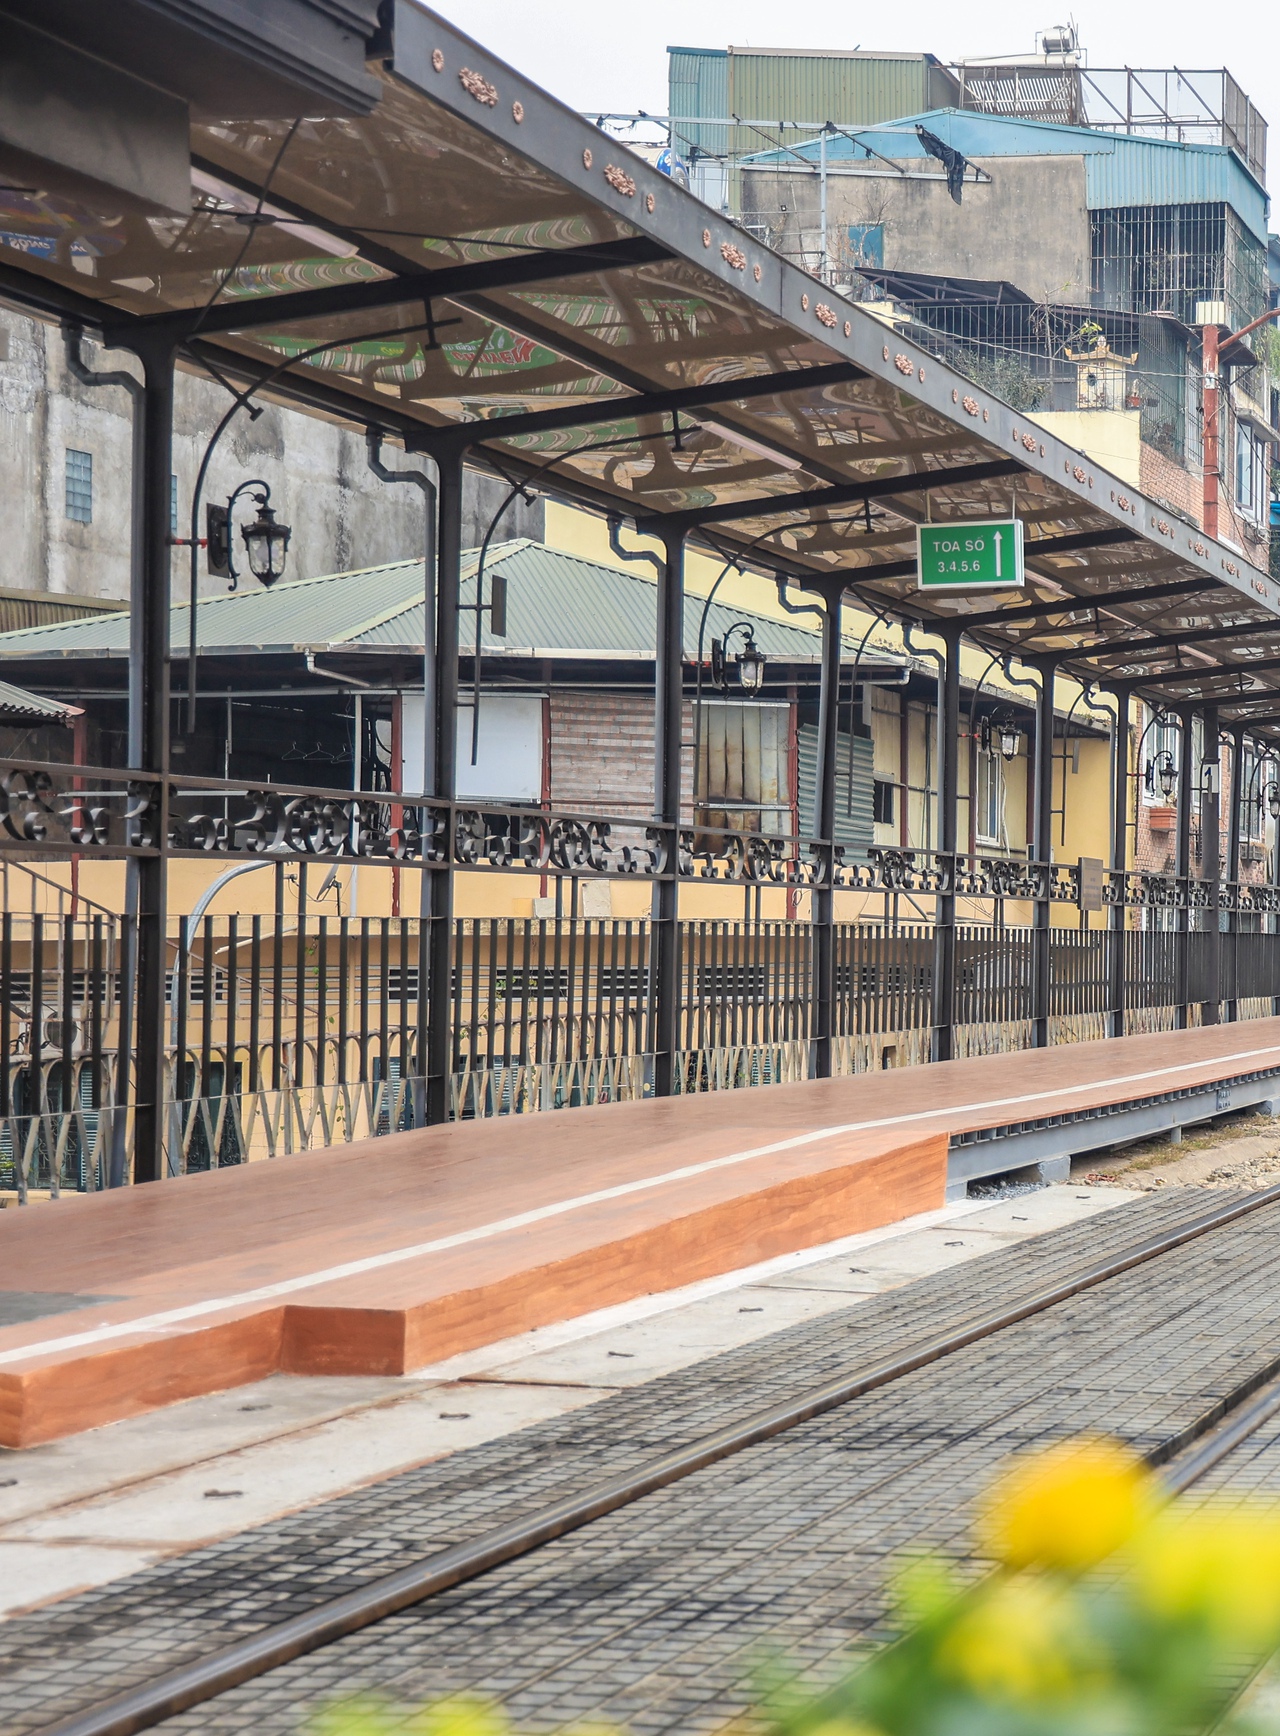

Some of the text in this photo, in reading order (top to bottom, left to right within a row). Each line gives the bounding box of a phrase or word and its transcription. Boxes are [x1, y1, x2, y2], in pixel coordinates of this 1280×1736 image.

[933, 535, 985, 552] TOA SỐ
[938, 560, 981, 572] 3.4.5.6
